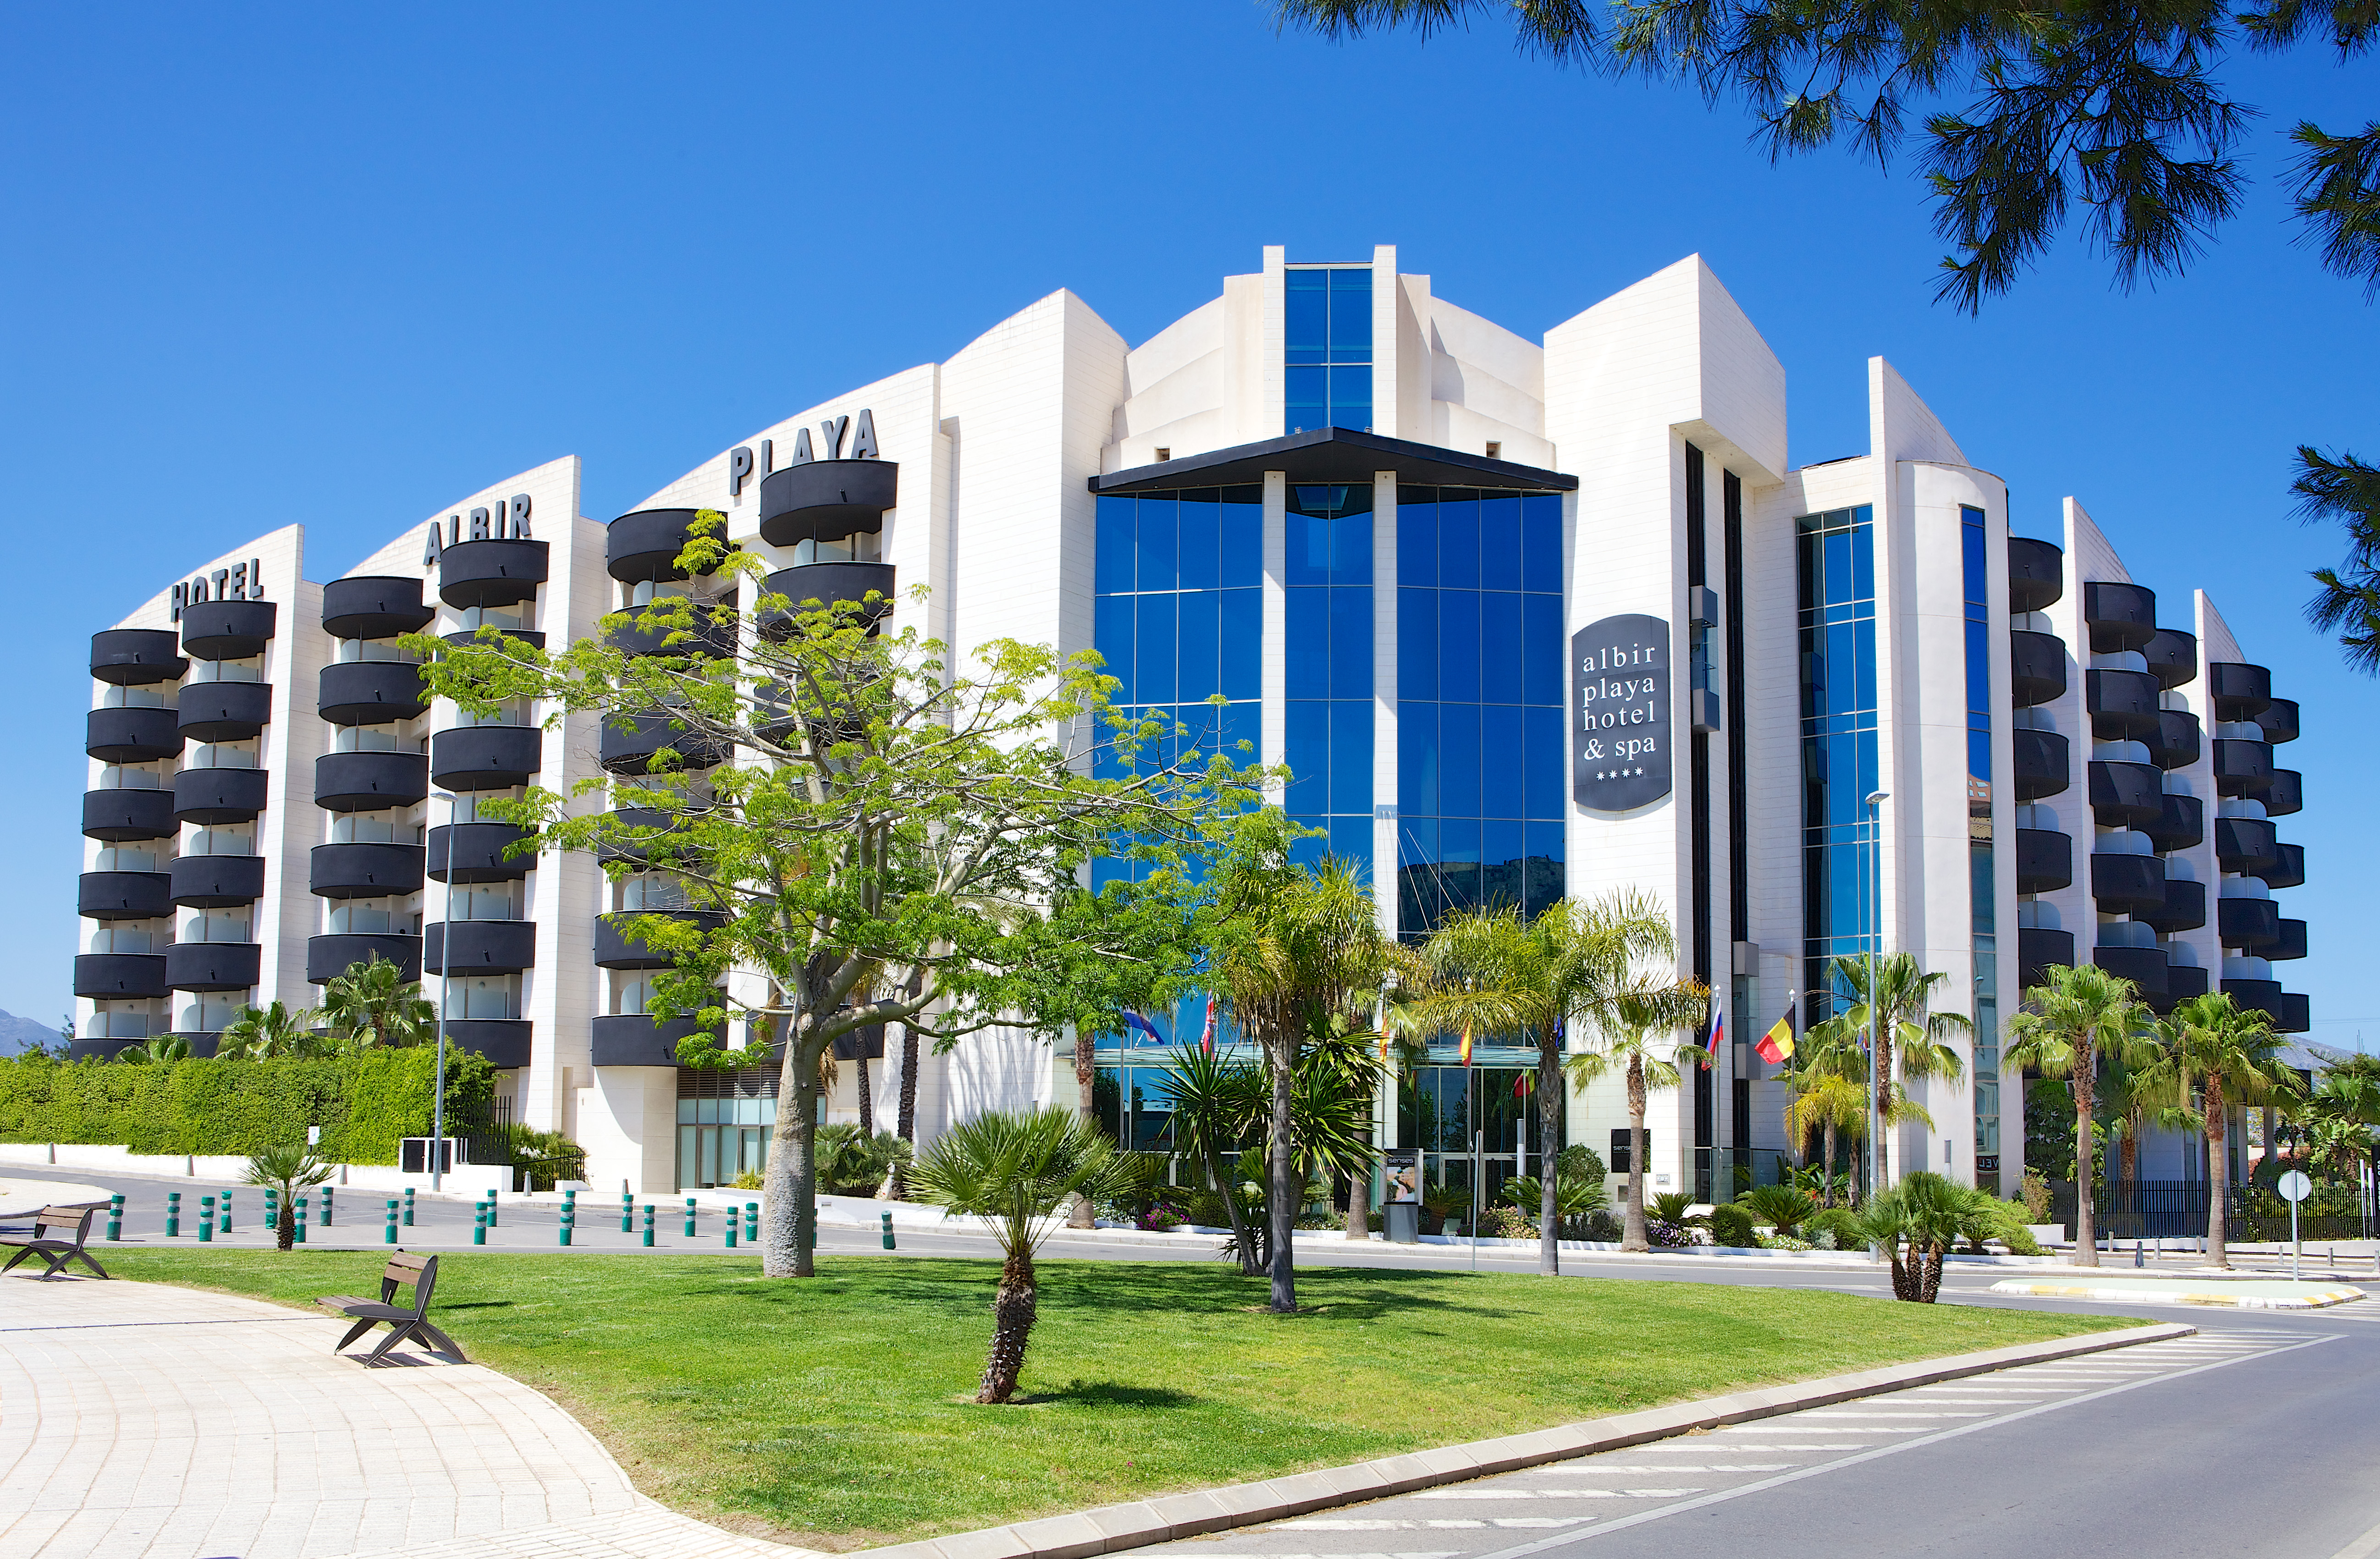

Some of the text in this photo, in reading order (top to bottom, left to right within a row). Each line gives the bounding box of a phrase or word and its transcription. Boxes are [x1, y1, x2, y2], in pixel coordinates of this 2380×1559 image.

[730, 408, 879, 496] PLAYA
[423, 493, 532, 566] ALBIR
[171, 558, 264, 623] HOTEL
[1583, 643, 1655, 672] albir
[1582, 677, 1656, 708] playa
[1583, 700, 1655, 732] hotel
[1584, 736, 1656, 761] & spa
